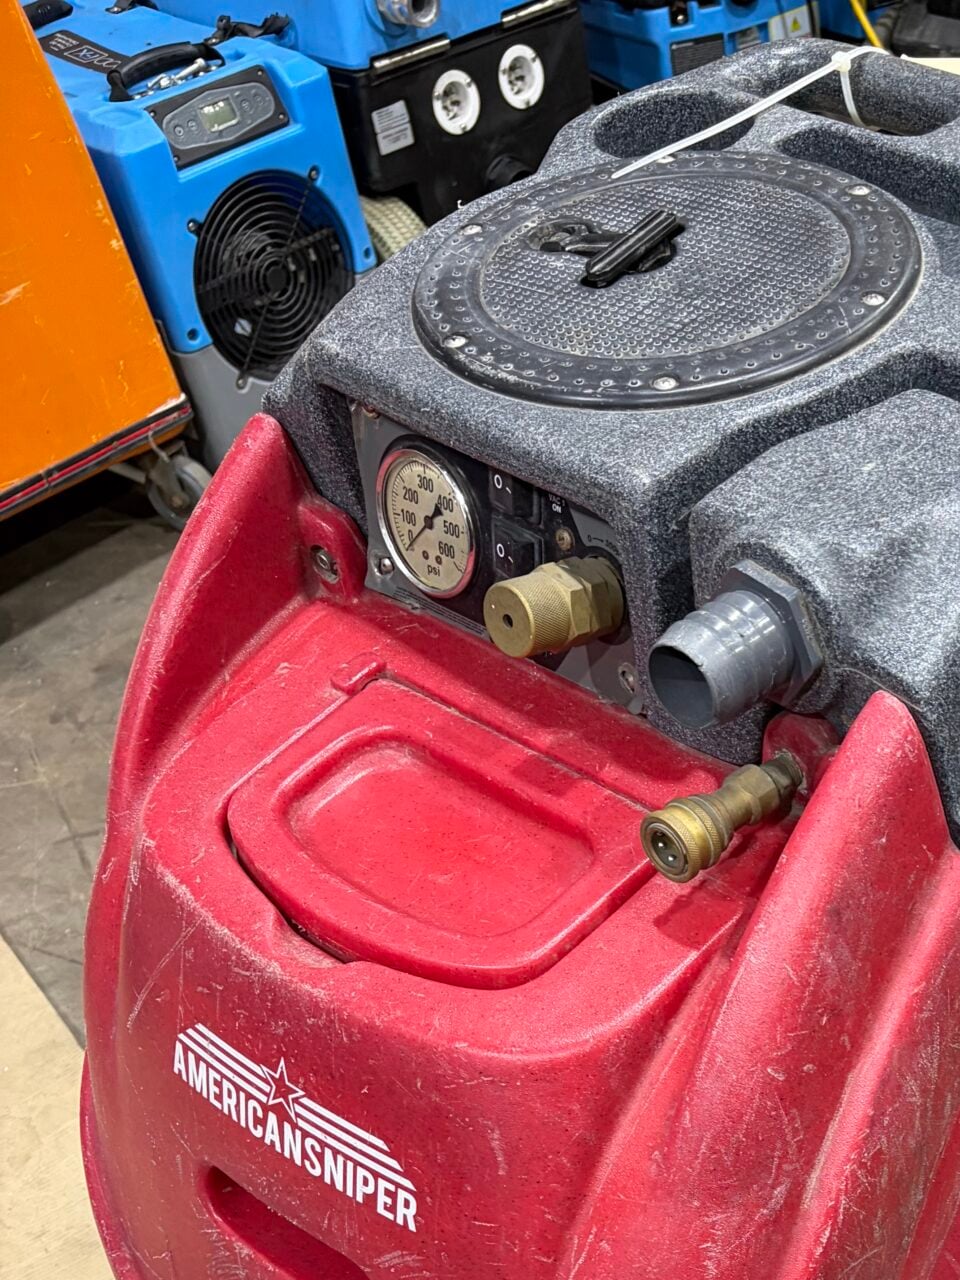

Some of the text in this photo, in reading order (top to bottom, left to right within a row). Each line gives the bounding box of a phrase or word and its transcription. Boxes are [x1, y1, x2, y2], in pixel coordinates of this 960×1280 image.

[417, 474, 434, 493] 300
[403, 486, 419, 505] 200
[437, 495, 454, 513] 400
[552, 503, 562, 513] ON
[401, 508, 416, 527] 100
[408, 529, 414, 542] 0
[443, 520, 460, 539] 500
[438, 541, 455, 559] 600
[427, 564, 441, 577] psi
